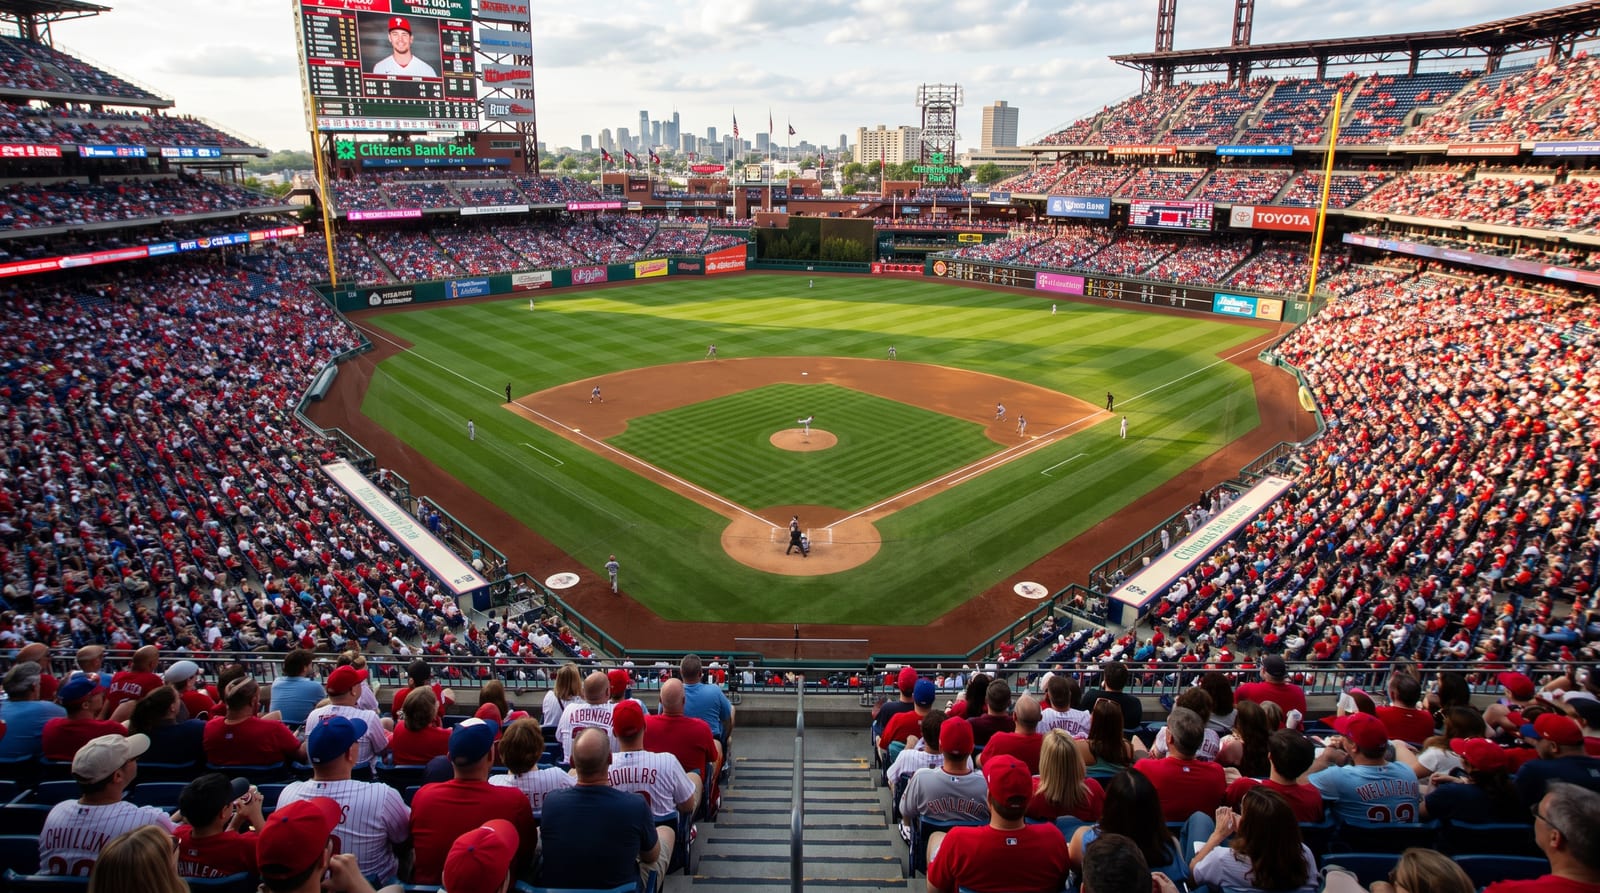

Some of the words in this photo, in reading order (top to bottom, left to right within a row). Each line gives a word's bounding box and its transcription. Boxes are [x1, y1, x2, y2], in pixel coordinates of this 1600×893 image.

[359, 143, 412, 157] Citizens
[415, 143, 446, 156] Bank
[448, 143, 475, 156] Park
[943, 166, 964, 174] Bank
[928, 174, 947, 182] Park
[1256, 212, 1311, 226] TOYOTA
